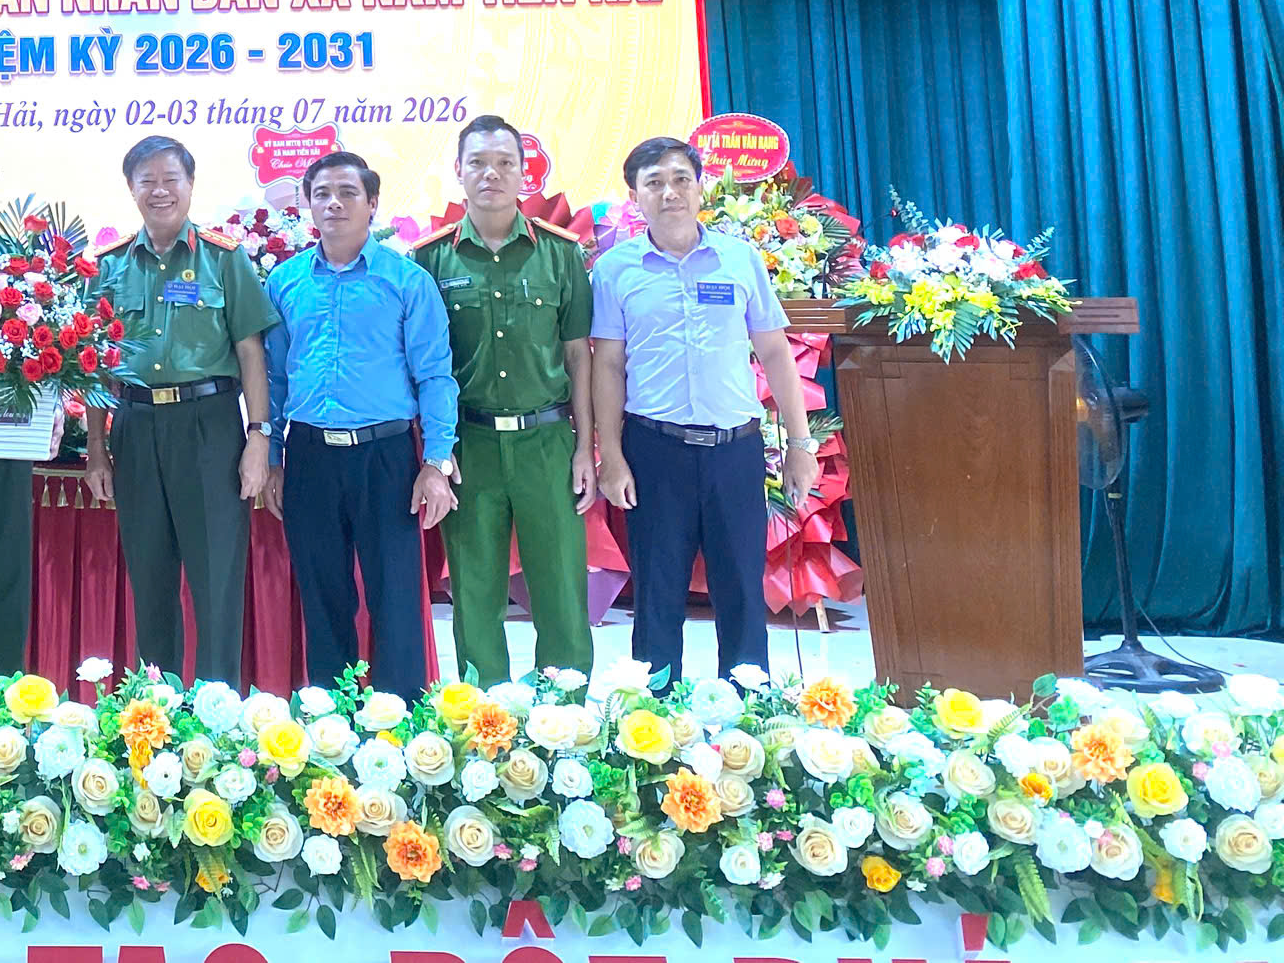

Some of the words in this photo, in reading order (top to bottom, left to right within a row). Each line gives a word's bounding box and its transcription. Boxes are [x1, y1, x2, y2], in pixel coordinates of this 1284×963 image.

[69, 26, 123, 74] KỲ
[134, 33, 236, 74] 2026
[247, 47, 266, 59] -
[277, 31, 376, 72] 2031
[52, 102, 117, 136] ngày
[124, 98, 198, 126] 02-03
[207, 97, 284, 129] tháng
[293, 97, 326, 124] 07
[334, 97, 393, 123] năm
[402, 96, 468, 123] 2026
